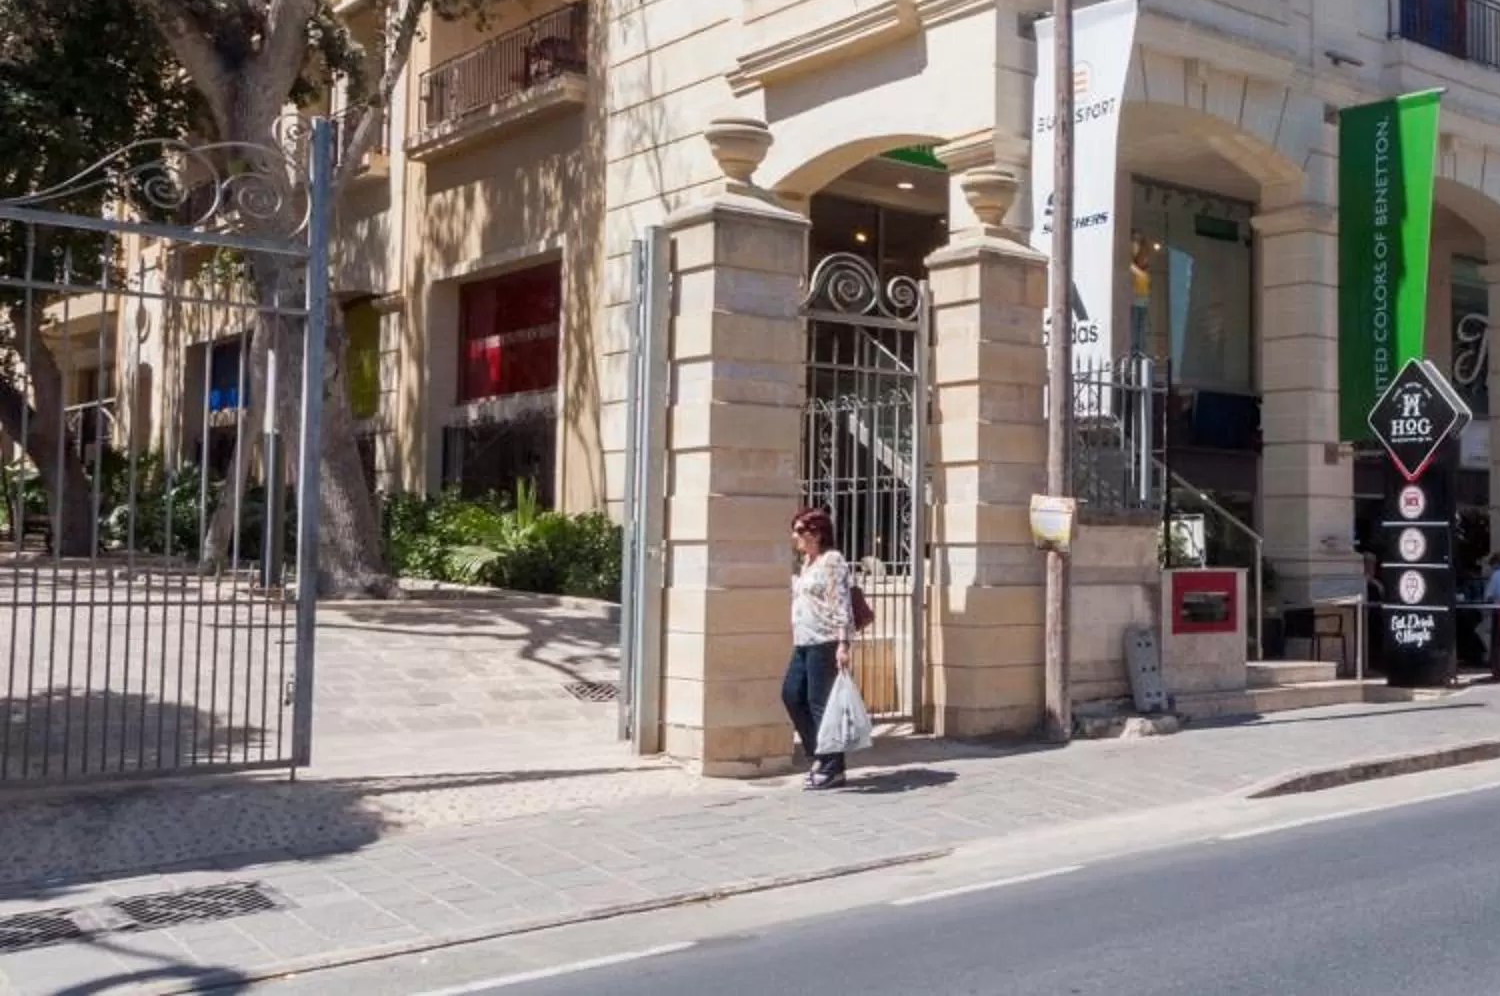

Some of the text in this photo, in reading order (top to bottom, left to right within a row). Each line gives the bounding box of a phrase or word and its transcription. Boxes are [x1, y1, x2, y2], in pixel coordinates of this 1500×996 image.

[1036, 97, 1116, 133] EUSPORT
[1374, 231, 1388, 259] OF
[1374, 260, 1388, 342] COLORS
[1375, 347, 1389, 398] ITED
[1390, 417, 1433, 436] HOG
